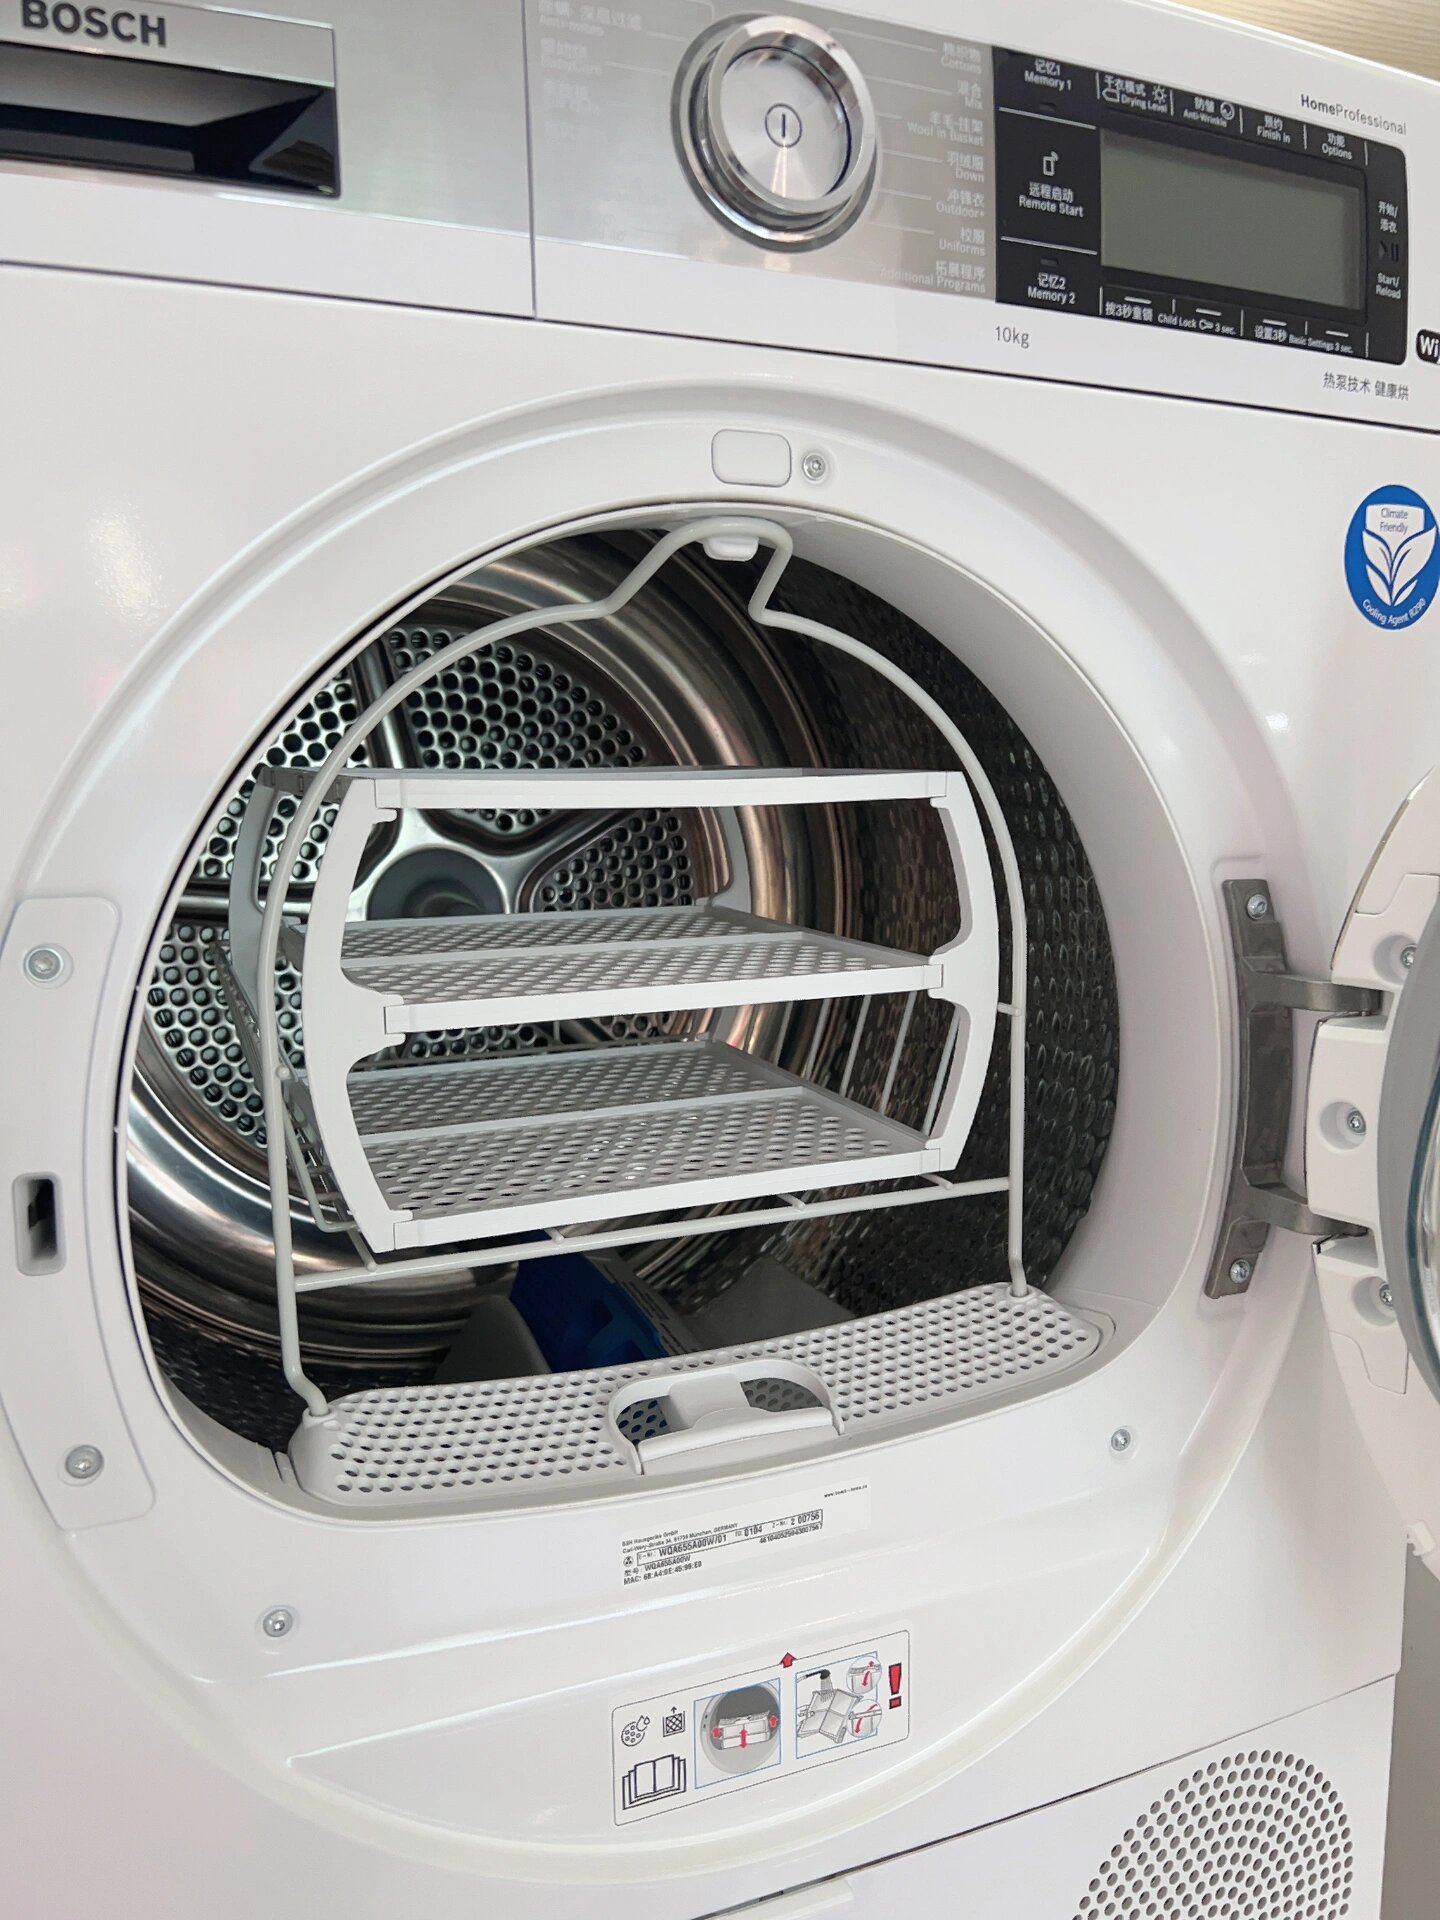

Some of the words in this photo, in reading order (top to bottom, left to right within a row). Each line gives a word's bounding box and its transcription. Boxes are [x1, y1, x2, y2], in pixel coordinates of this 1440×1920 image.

[21, 0, 167, 47] BOSCH
[940, 55, 982, 74] Cottons
[1024, 70, 1065, 90] Memory
[1066, 80, 1072, 91] 1
[965, 96, 983, 110] Mix
[1121, 94, 1147, 110] Drying
[1147, 101, 1168, 114] Level
[1183, 109, 1227, 128] Anti-Wrinkle
[1300, 94, 1407, 135] HomeProfessional
[906, 121, 933, 137] Wool
[936, 126, 946, 139] in
[950, 129, 984, 147] Basket
[1256, 127, 1282, 142] Finish
[1283, 132, 1291, 144] in
[1327, 132, 1345, 148] 功能
[1322, 144, 1352, 160] Options
[955, 167, 985, 183] Down
[1029, 182, 1074, 203] 远程启动
[1019, 196, 1057, 214] Remote
[1059, 204, 1084, 218] Start
[960, 227, 985, 244] 校服
[938, 239, 985, 256] Uniforms
[937, 276, 986, 293] Programs
[1377, 272, 1400, 288] Start/
[1028, 284, 1067, 305] Memory
[1068, 292, 1076, 305] 2
[1376, 284, 1401, 300] Reload
[1157, 313, 1178, 326] Child
[1179, 317, 1197, 329] Lock
[1214, 323, 1220, 333] 3
[1221, 326, 1236, 335] sec.
[995, 326, 1030, 349] 10kg
[1289, 334, 1307, 346] Basic
[1308, 337, 1334, 352] Settings
[1335, 342, 1340, 352] 3
[1340, 345, 1354, 354] sec.
[1323, 371, 1371, 394] 热泵技术
[1374, 380, 1410, 401] 健康烘
[1380, 508, 1408, 520] Climate
[1379, 521, 1408, 535] Friendly
[1362, 599, 1387, 625] Cooling
[1388, 614, 1409, 627] Agent
[1409, 597, 1427, 619] R290
[658, 1534, 727, 1557] WQA655A00W/01
[744, 1525, 763, 1537] 0104
[797, 1511, 820, 1524] 00756
[713, 1523, 738, 1533] GERMANY
[644, 1555, 691, 1572] WQA655A00W
[623, 1577, 642, 1586] MAC:
